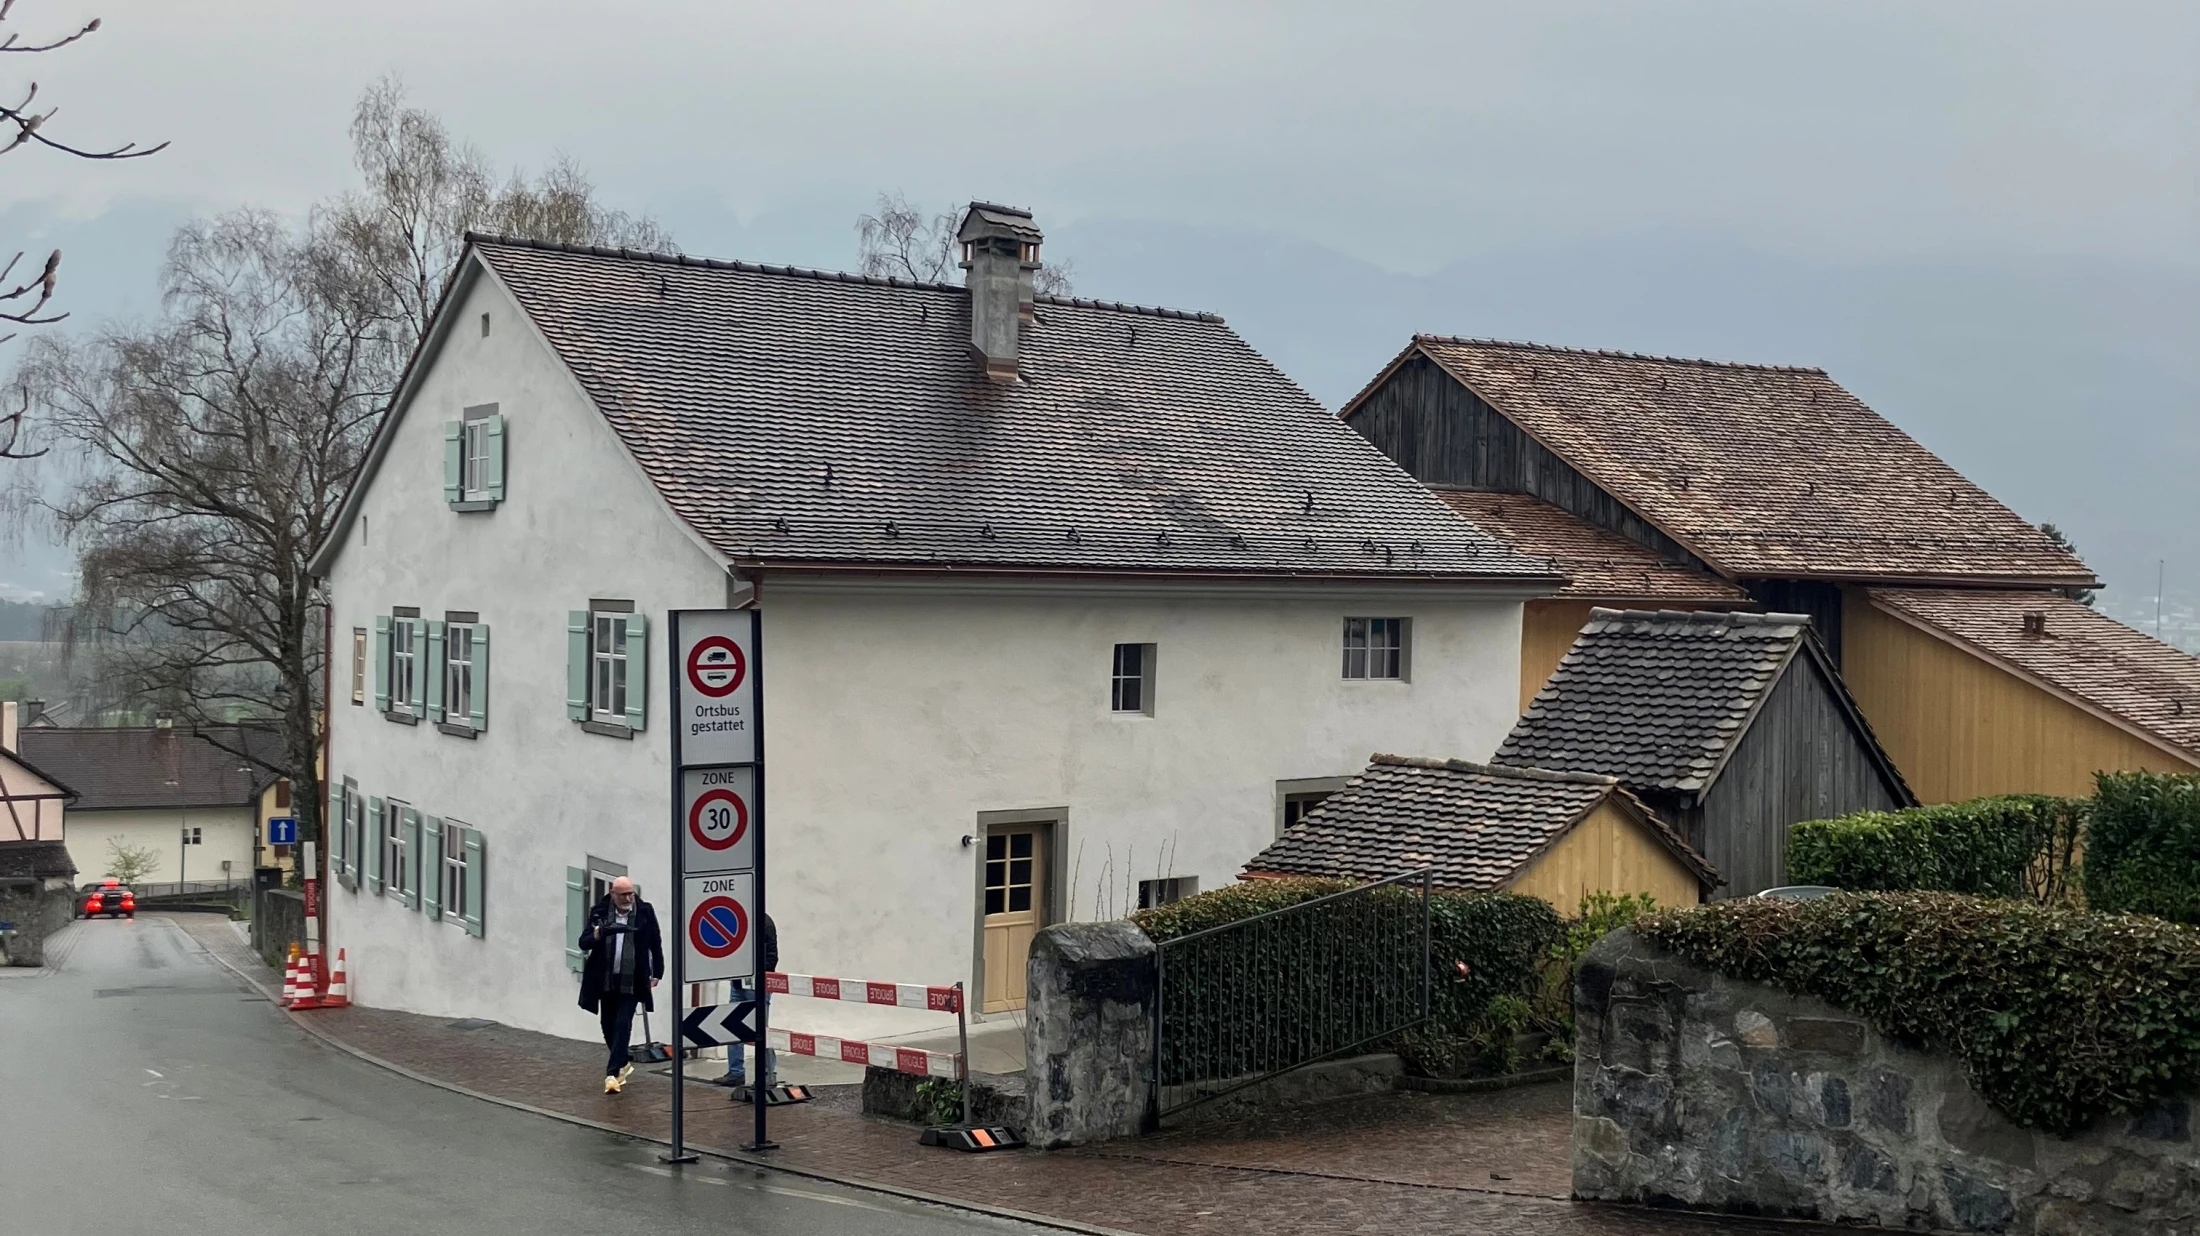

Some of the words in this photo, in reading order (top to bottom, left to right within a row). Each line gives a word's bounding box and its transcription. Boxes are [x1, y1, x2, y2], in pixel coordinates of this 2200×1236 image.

[695, 704, 740, 718] Ortsbus
[691, 719, 745, 736] gestattet
[702, 772, 735, 785] ZONE
[707, 808, 730, 830] 30
[702, 879, 735, 893] ZONE
[307, 882, 316, 914] BROGLE
[869, 987, 895, 1002] BROGLE
[930, 992, 958, 1007] BOGLE
[792, 1037, 813, 1051] BROGLE
[843, 1045, 867, 1060] BROGLE
[899, 1053, 925, 1069] BROGLE
